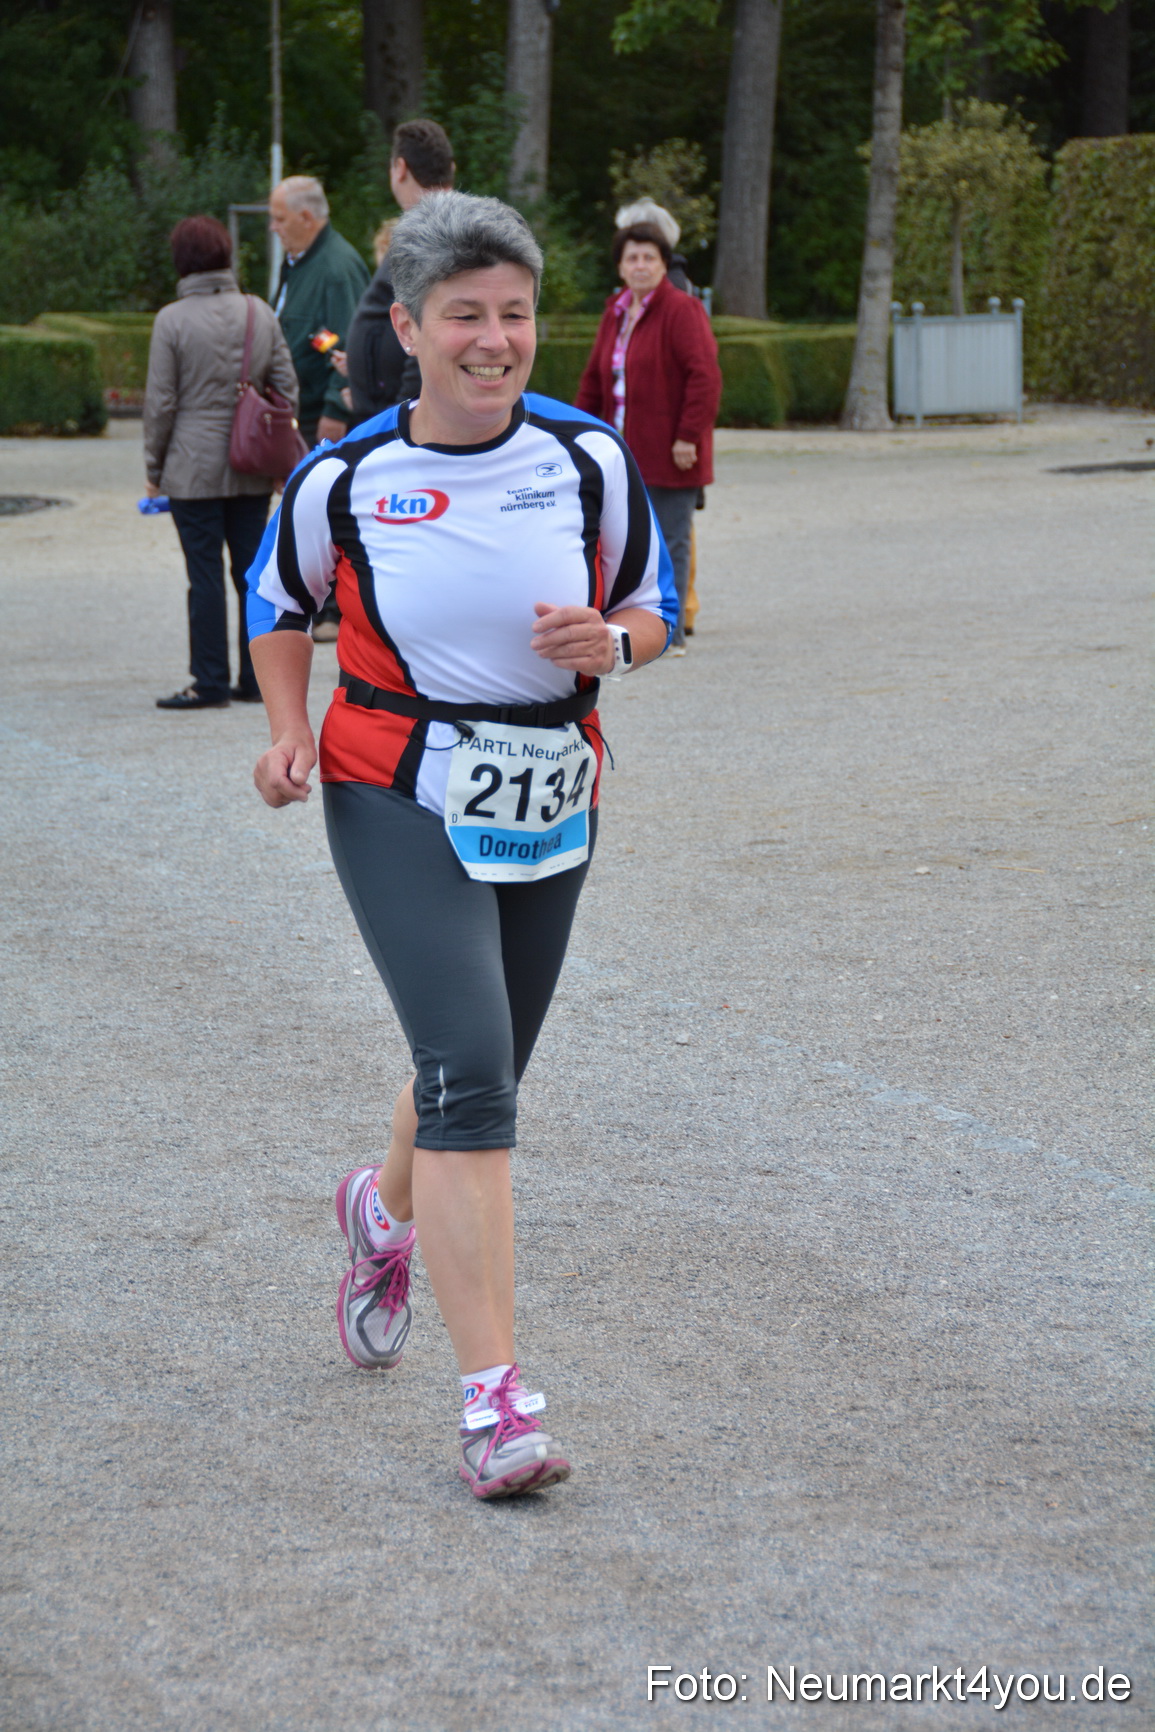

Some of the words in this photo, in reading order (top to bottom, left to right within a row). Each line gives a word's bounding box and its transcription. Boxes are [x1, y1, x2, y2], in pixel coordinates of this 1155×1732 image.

[506, 486, 533, 495] team
[515, 490, 555, 501] klinikum
[375, 493, 427, 514] tkn
[500, 500, 545, 512] nürnberg
[459, 735, 517, 756] PARTL
[463, 757, 590, 823] 2134
